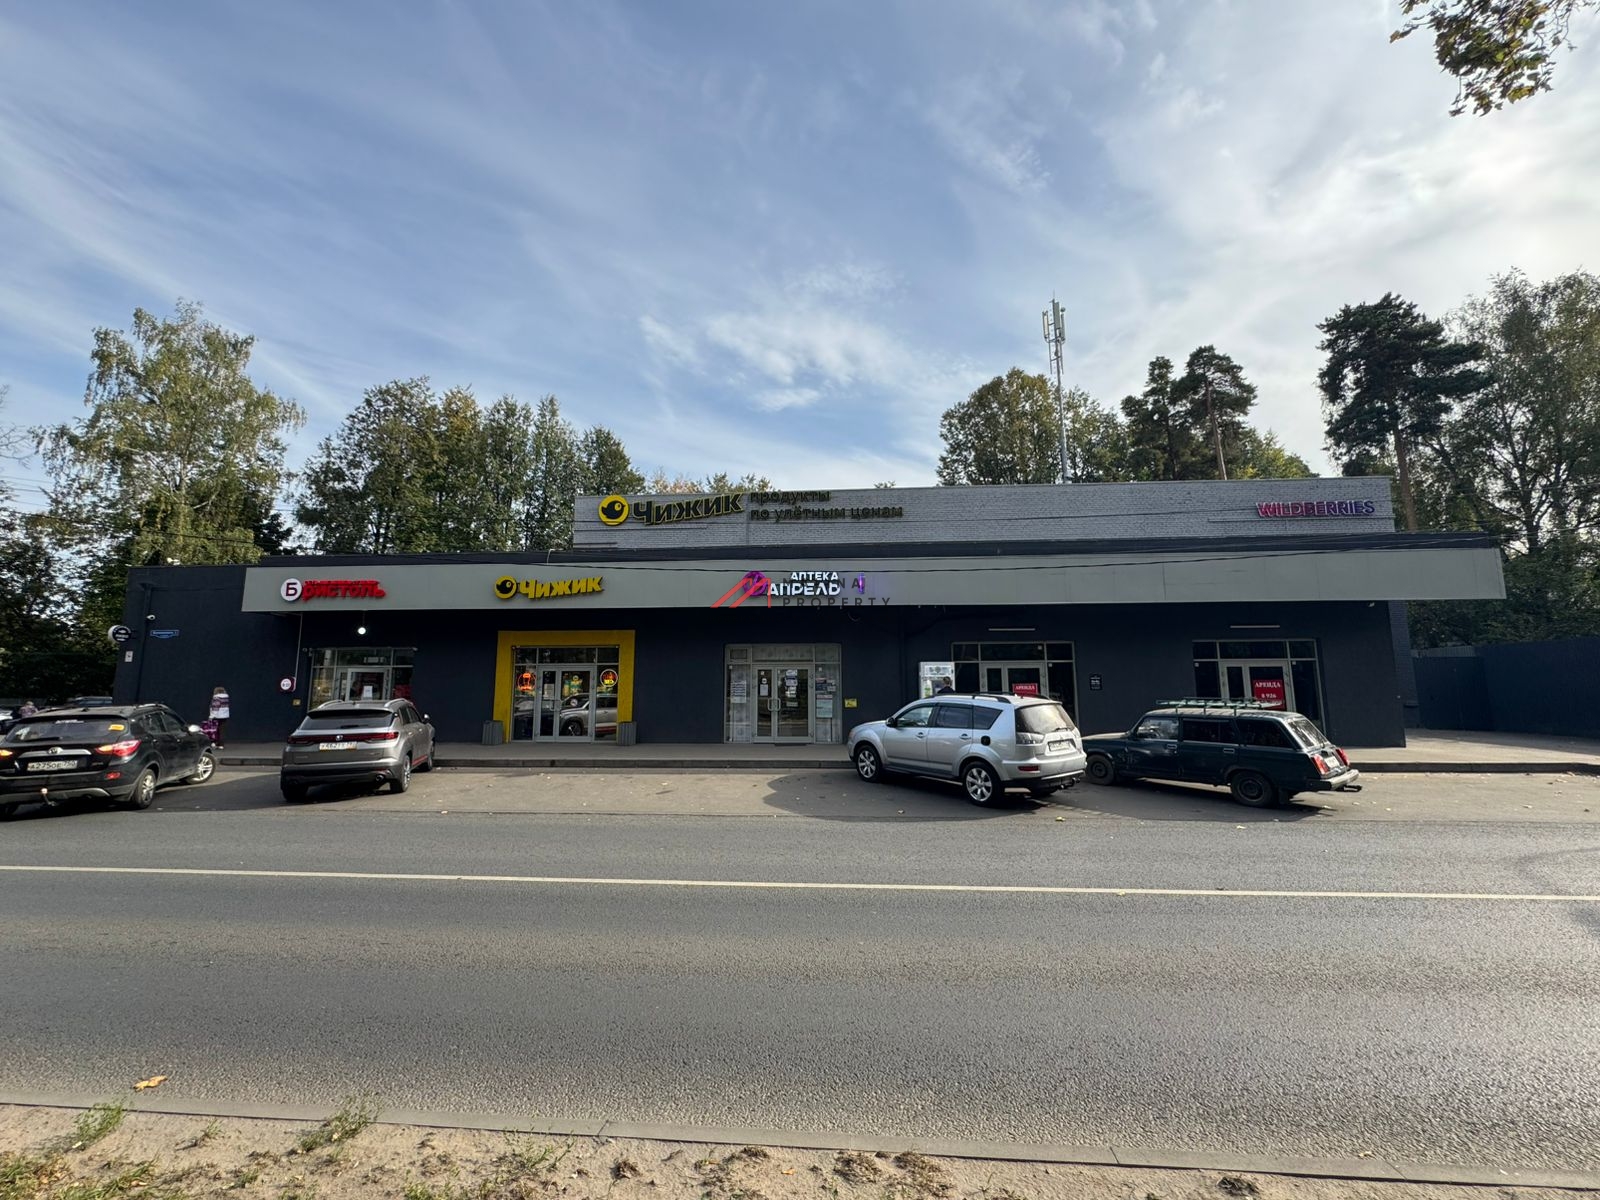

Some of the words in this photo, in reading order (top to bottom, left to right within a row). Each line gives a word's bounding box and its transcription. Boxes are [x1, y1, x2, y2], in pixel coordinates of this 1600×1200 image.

[750, 490, 832, 505] продукты
[750, 508, 770, 520] по
[850, 505, 904, 519] ценам
[1256, 499, 1376, 517] WILDBERRIES
[790, 571, 840, 581] АПТЕКА
[767, 582, 841, 596] АПРЕЛЬ
[1254, 681, 1281, 689] АРЕНДА
